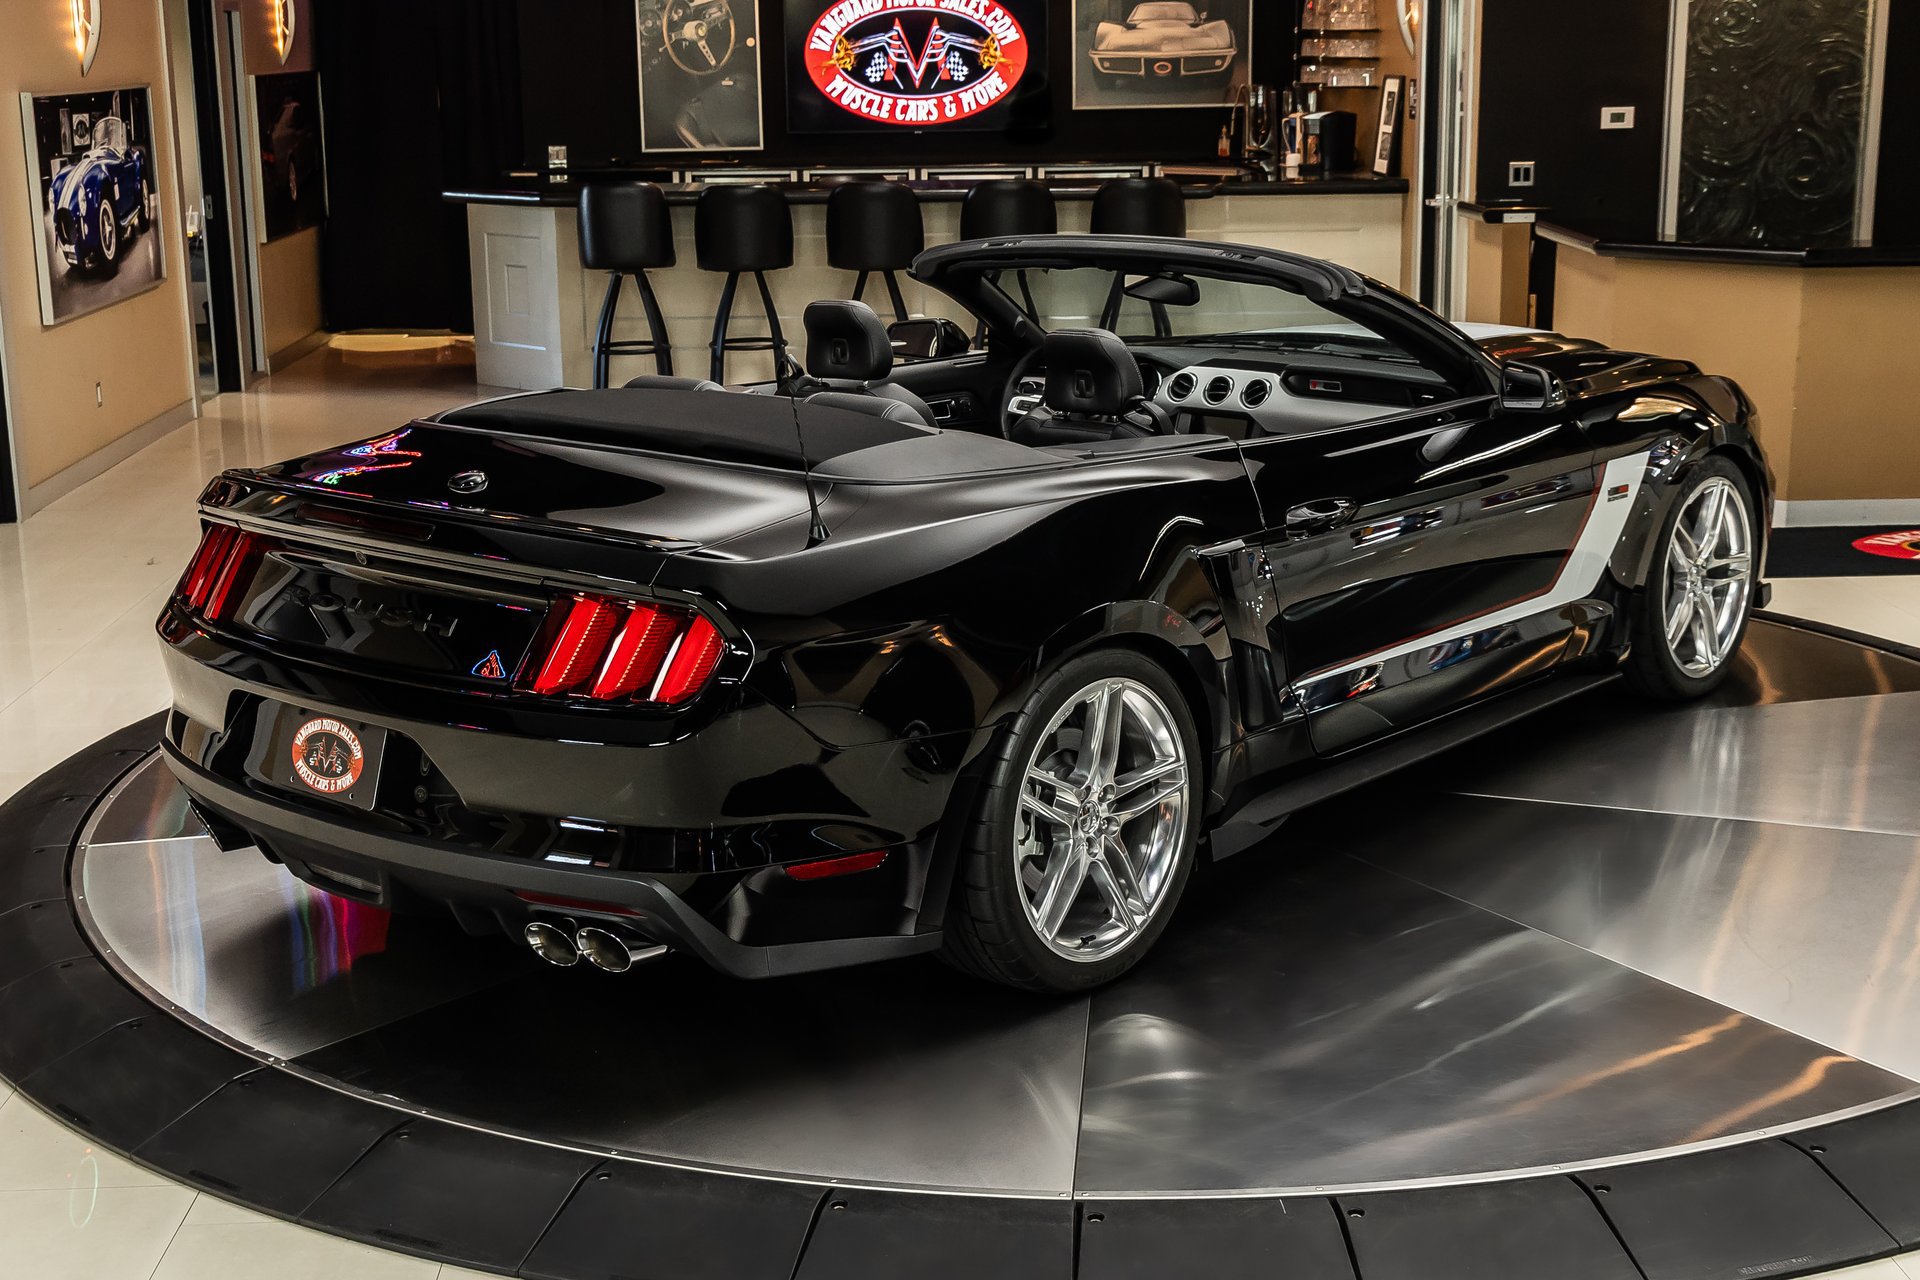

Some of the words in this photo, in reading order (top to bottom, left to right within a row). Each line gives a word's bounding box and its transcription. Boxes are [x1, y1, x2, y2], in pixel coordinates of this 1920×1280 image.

[809, 0, 883, 52] VANGUARD
[825, 74, 893, 119] MUSCLE
[895, 99, 938, 121] CARS
[942, 95, 957, 118] &
[958, 71, 1008, 113] MORE
